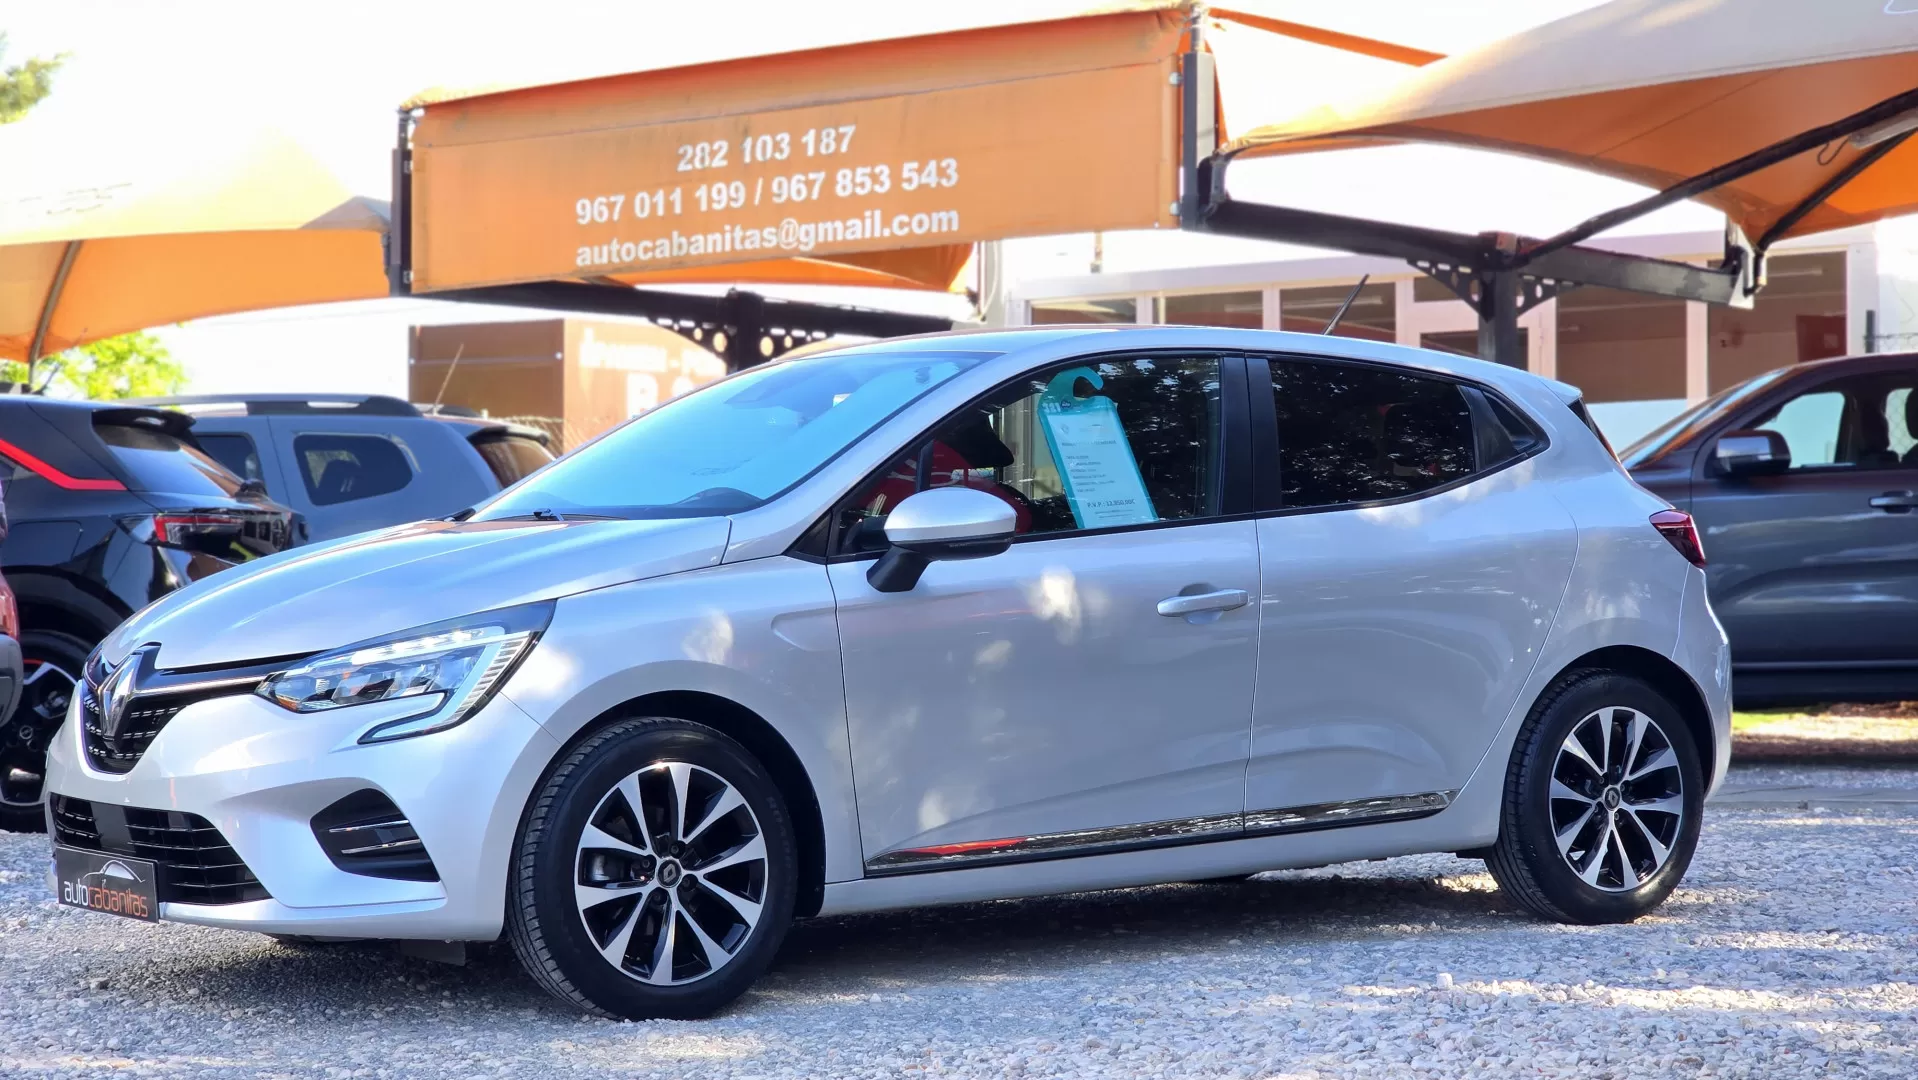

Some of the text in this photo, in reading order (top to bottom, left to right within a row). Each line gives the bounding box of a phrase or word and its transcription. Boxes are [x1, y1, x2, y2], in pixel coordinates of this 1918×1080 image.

[677, 125, 856, 171] 282 103 187
[576, 158, 958, 224] 967 011 199 / 967 853 543
[576, 209, 959, 266] autocabanitas@gmail.com
[63, 878, 149, 918] autocabanitas
